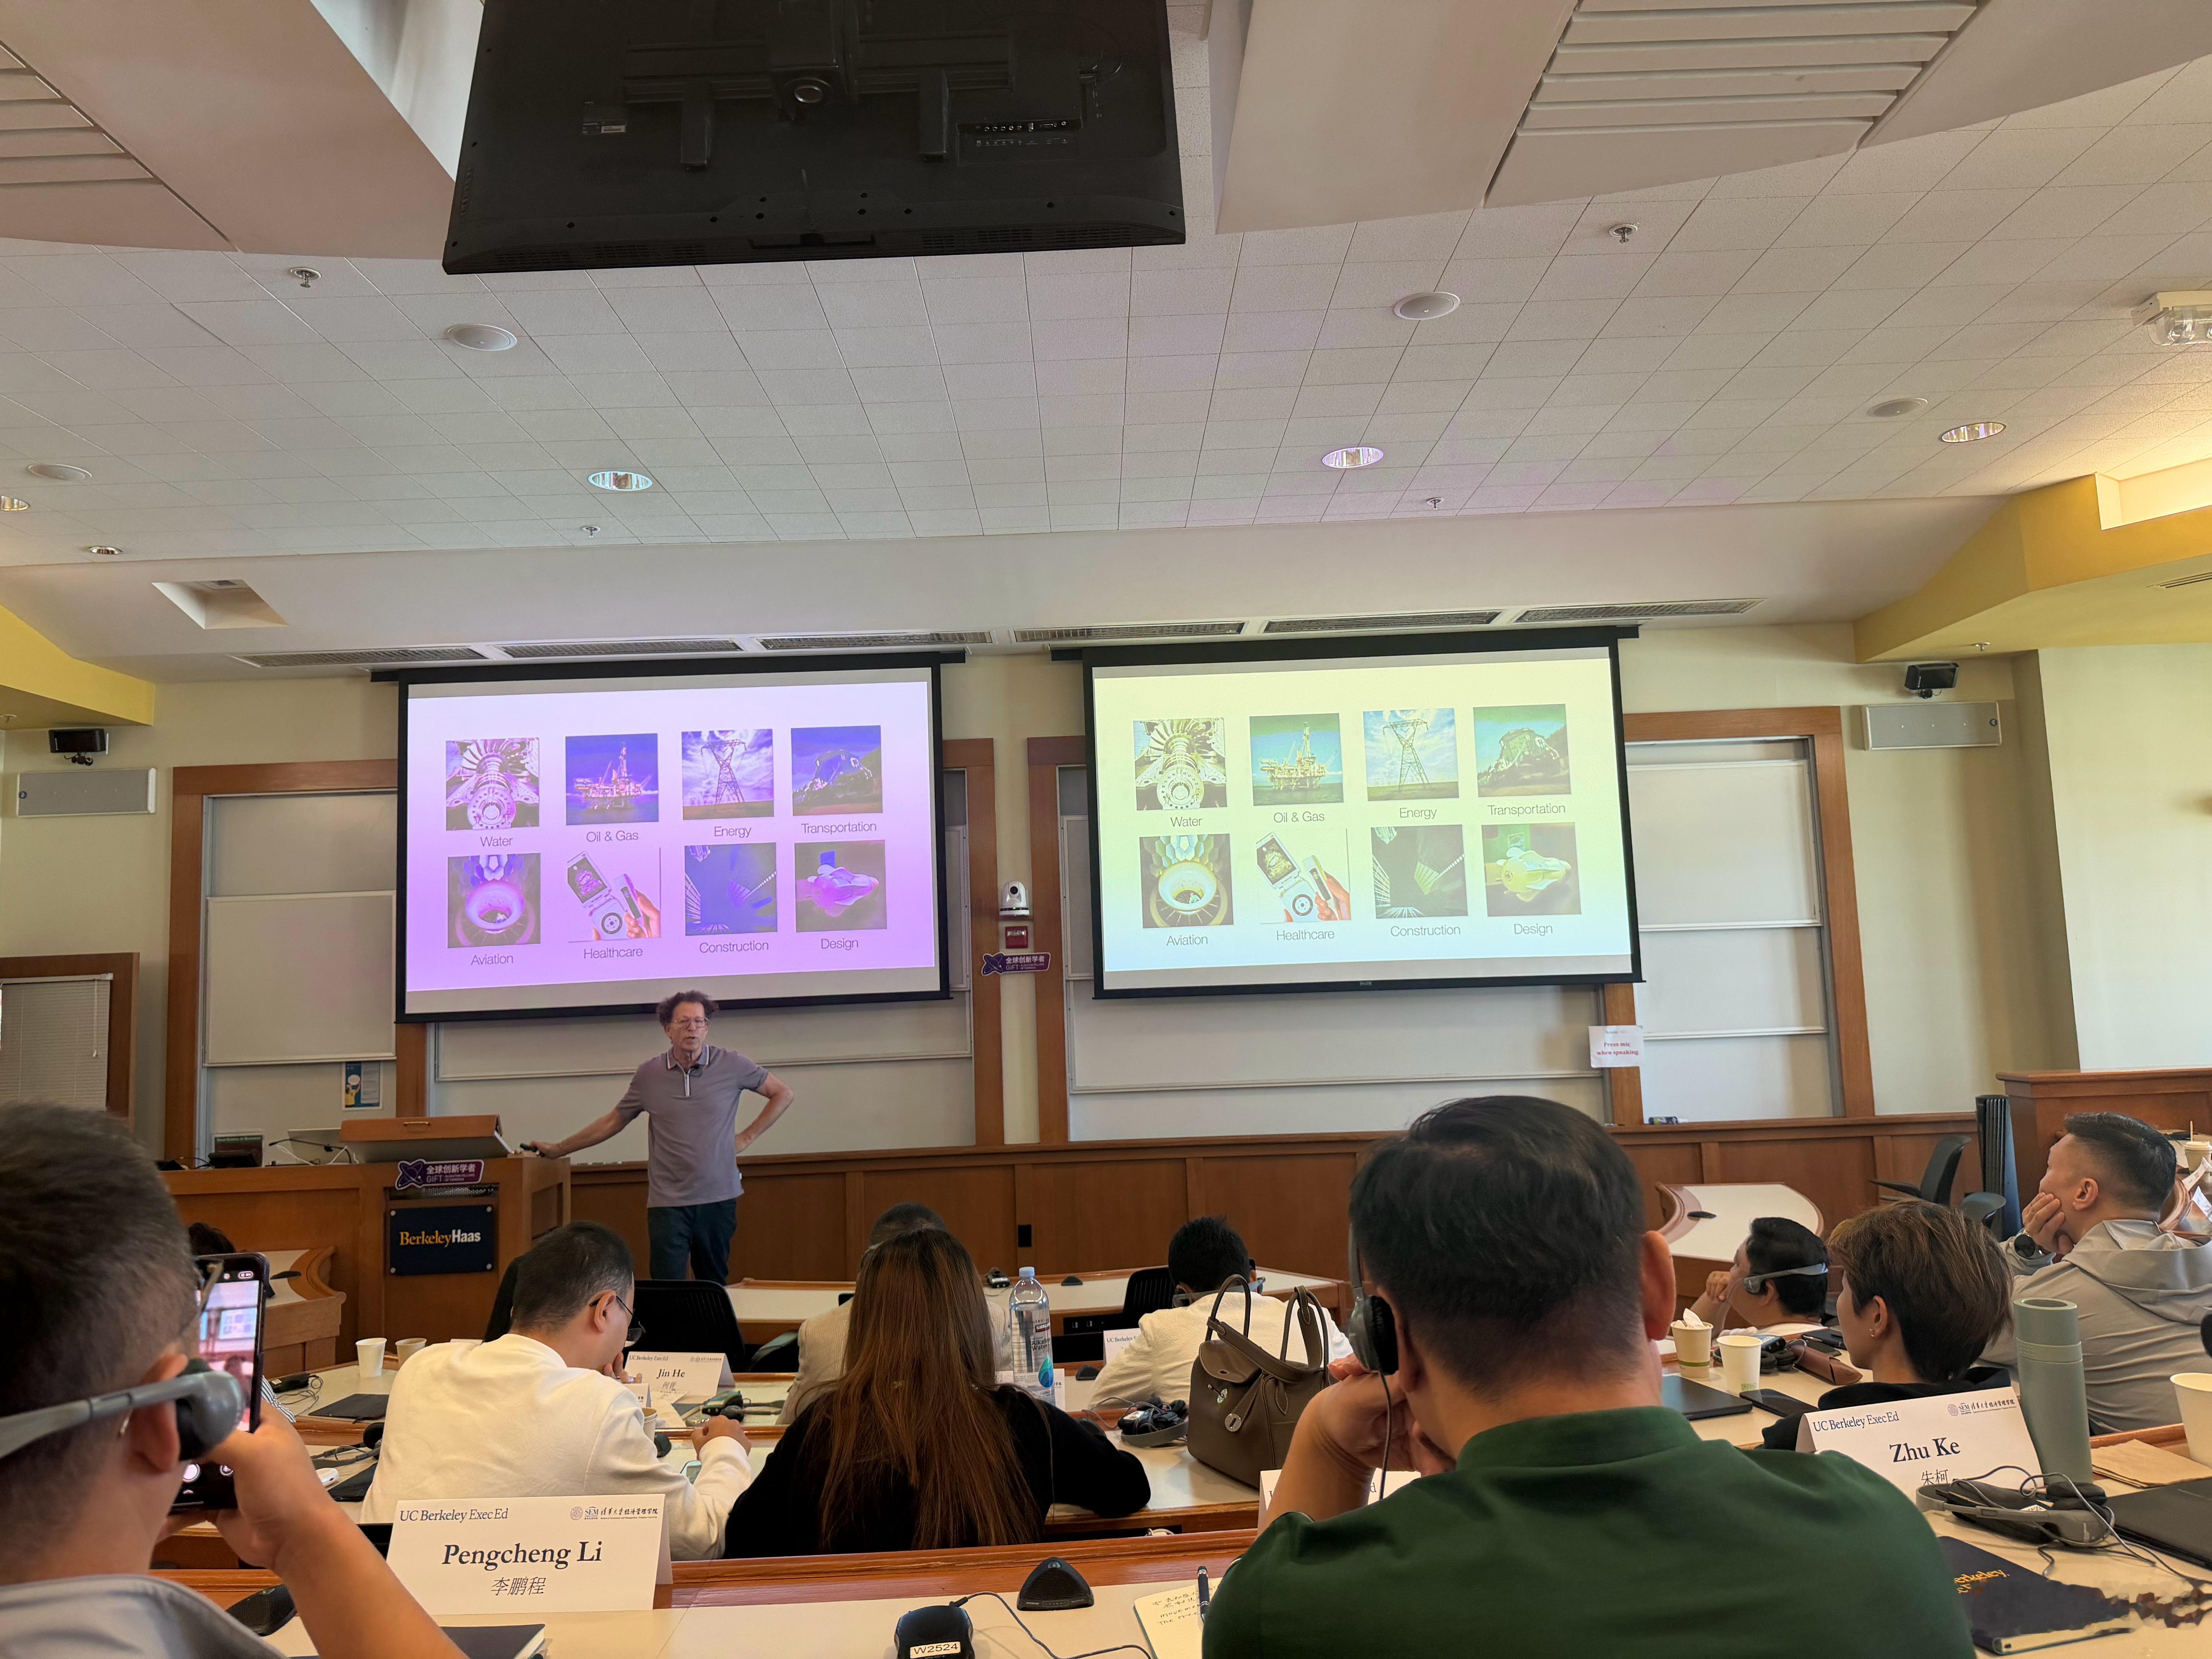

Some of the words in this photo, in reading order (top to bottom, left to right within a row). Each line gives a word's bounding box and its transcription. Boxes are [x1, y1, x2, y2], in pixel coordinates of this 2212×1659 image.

[1400, 808, 1437, 820] Energy
[1487, 803, 1565, 816] Transportation
[1170, 816, 1202, 827] Water
[1274, 812, 1287, 823] Oil
[1291, 812, 1299, 822] &
[1303, 811, 1325, 822] Gas
[714, 826, 752, 838] Energy
[801, 821, 877, 835] Transportation
[480, 836, 513, 847] Water
[586, 831, 600, 842] Oil
[605, 831, 613, 841] &
[616, 830, 639, 841] Gas
[1277, 929, 1334, 941] Healthcare
[1391, 924, 1461, 937] Construction
[1514, 923, 1553, 936] Design
[821, 938, 859, 951] Design
[1166, 934, 1208, 946] Aviation
[699, 940, 769, 953] Construction
[471, 953, 514, 965] Aviation
[584, 947, 643, 959] Healthcare
[1006, 955, 1044, 964] 全球创新学者
[426, 1163, 476, 1175] 全球创新学者
[426, 1175, 443, 1183] GIFT
[656, 1369, 670, 1379] Jin
[1813, 1421, 1829, 1432] UC
[1829, 1417, 1865, 1429] Berkeley
[1866, 1414, 1887, 1425] Exec
[1886, 1411, 1899, 1422] Ed
[1889, 1443, 1930, 1463] Zhu
[1932, 1437, 1961, 1456] Ke
[1921, 1469, 1948, 1486] 朱柯
[400, 1510, 419, 1521] UC
[420, 1509, 468, 1523] Berkeley
[469, 1509, 493, 1520] Exec
[494, 1508, 508, 1519] Ed
[442, 1543, 571, 1571] Pengcheng
[577, 1541, 602, 1561] Li
[491, 1577, 546, 1596] 李鹏程
[914, 1643, 958, 1654] W2524
